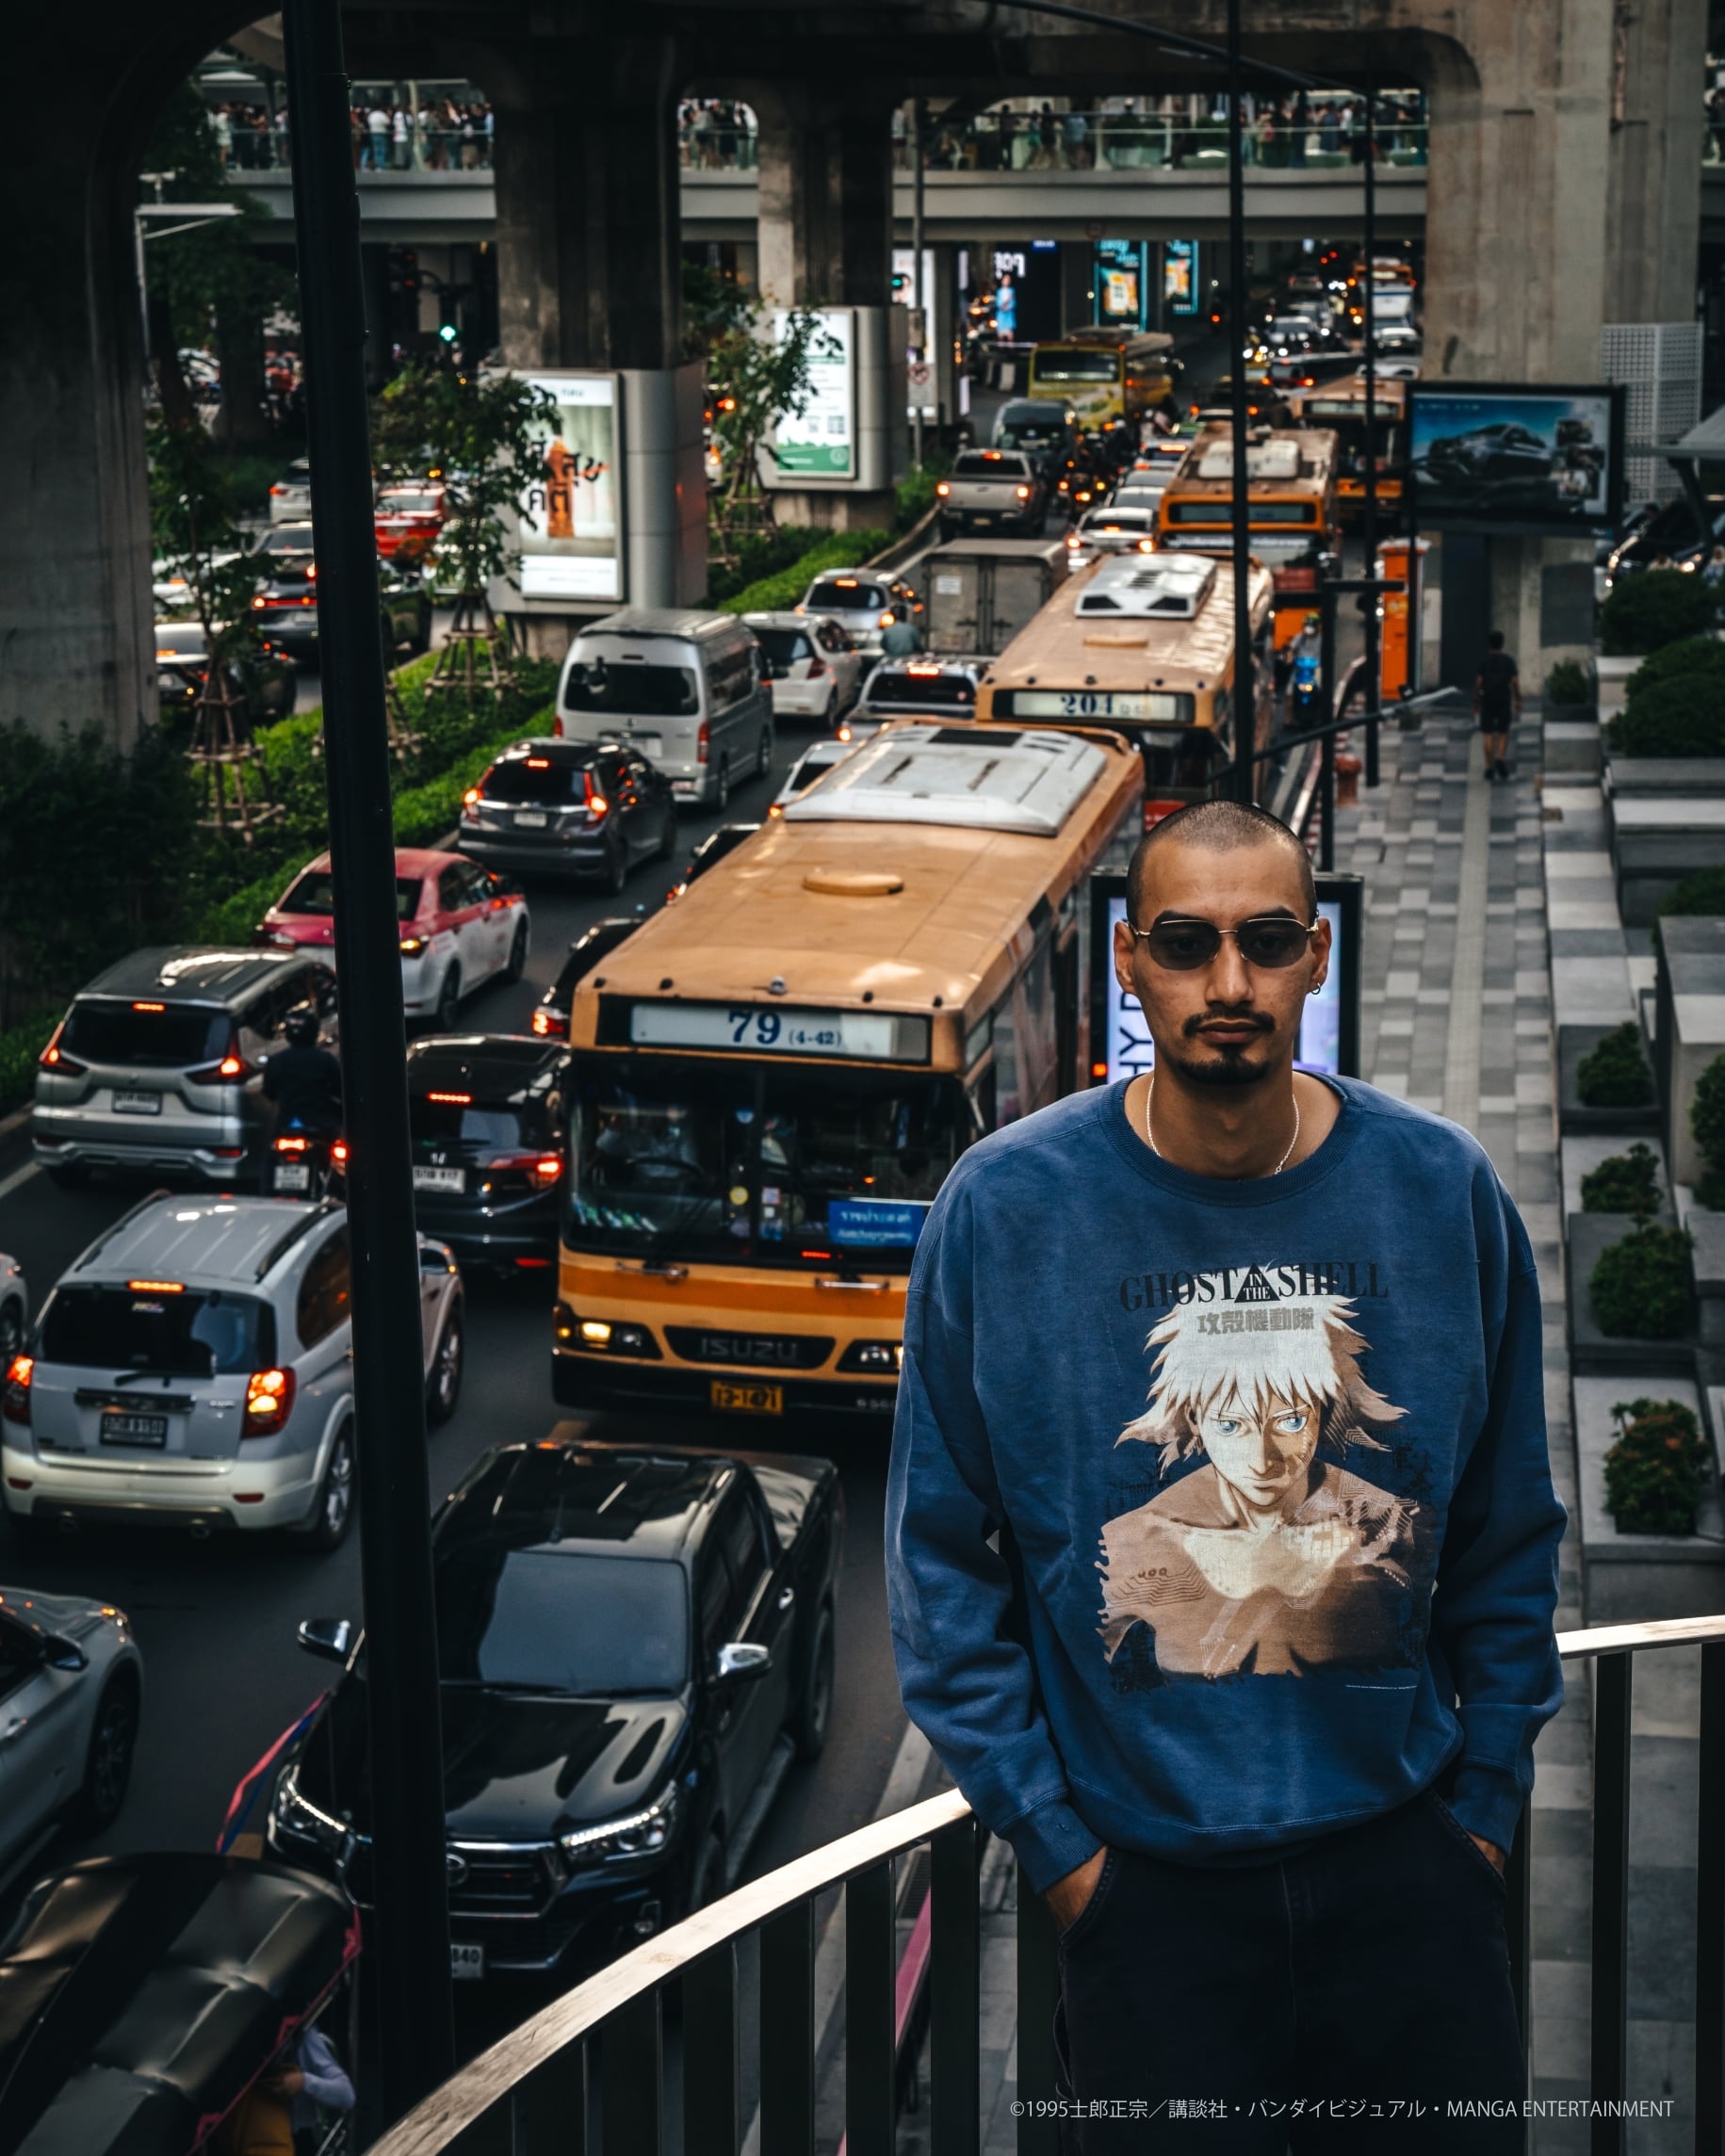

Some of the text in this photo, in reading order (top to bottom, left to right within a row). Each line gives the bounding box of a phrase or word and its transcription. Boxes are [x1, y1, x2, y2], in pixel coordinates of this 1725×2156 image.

[728, 1011, 842, 1046] 79 (4-42)
[1120, 1262, 1388, 1312] GHOST IN THE SHELL
[1197, 1307, 1314, 1336] 攻殻機動隊
[701, 1337, 797, 1359] ISUZU
